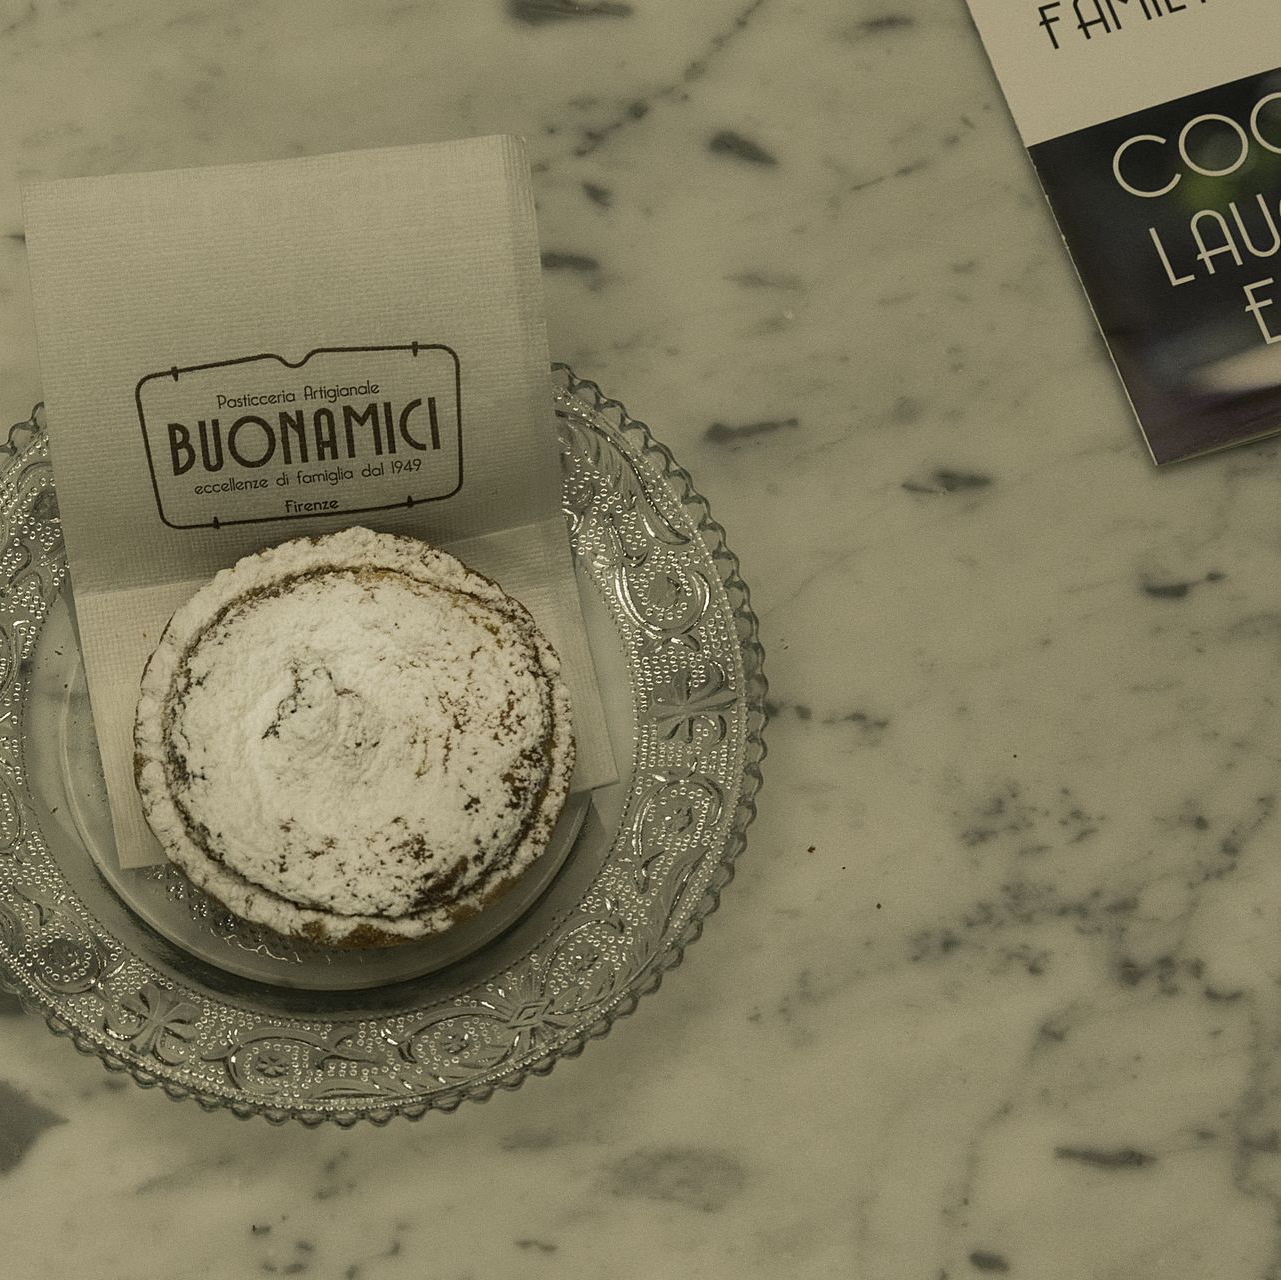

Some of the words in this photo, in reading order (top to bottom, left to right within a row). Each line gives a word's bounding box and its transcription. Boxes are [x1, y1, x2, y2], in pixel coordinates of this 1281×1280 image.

[1148, 192, 1281, 287] LAU
[216, 390, 296, 410] Pasticceria
[303, 379, 380, 404] Artigianale
[167, 396, 441, 476] BUONAMICI
[194, 477, 269, 496] eccellenze
[276, 473, 290, 488] di
[297, 466, 354, 488] famiglia
[361, 462, 385, 479] dal
[391, 458, 423, 475] 1949
[285, 497, 340, 514] Firenze
